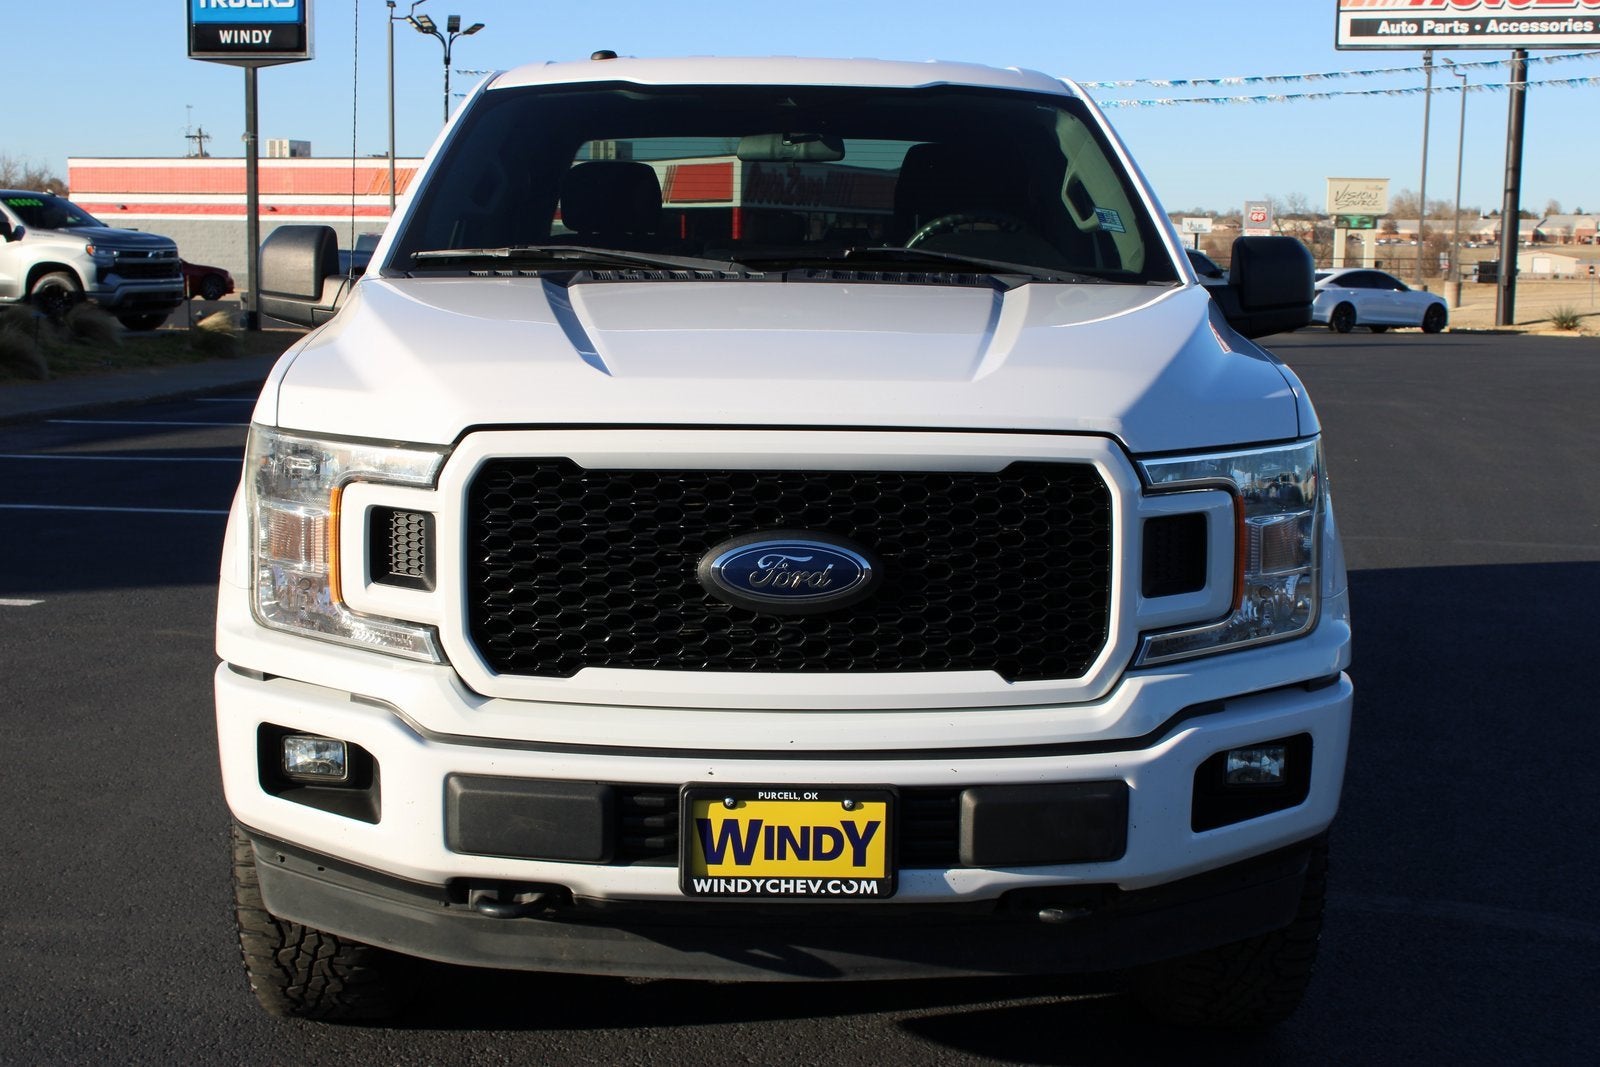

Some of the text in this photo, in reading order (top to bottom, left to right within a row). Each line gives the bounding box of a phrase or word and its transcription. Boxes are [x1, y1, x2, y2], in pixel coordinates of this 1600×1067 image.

[1378, 18, 1594, 34] Auto Parts Accessories
[219, 29, 272, 44] WINDY
[1251, 213, 1264, 221] 66
[748, 553, 834, 588] Ford
[758, 791, 819, 801] PURCELL, OK
[695, 818, 882, 868] WINDY
[692, 878, 879, 895] WINDYCHEV.COM
